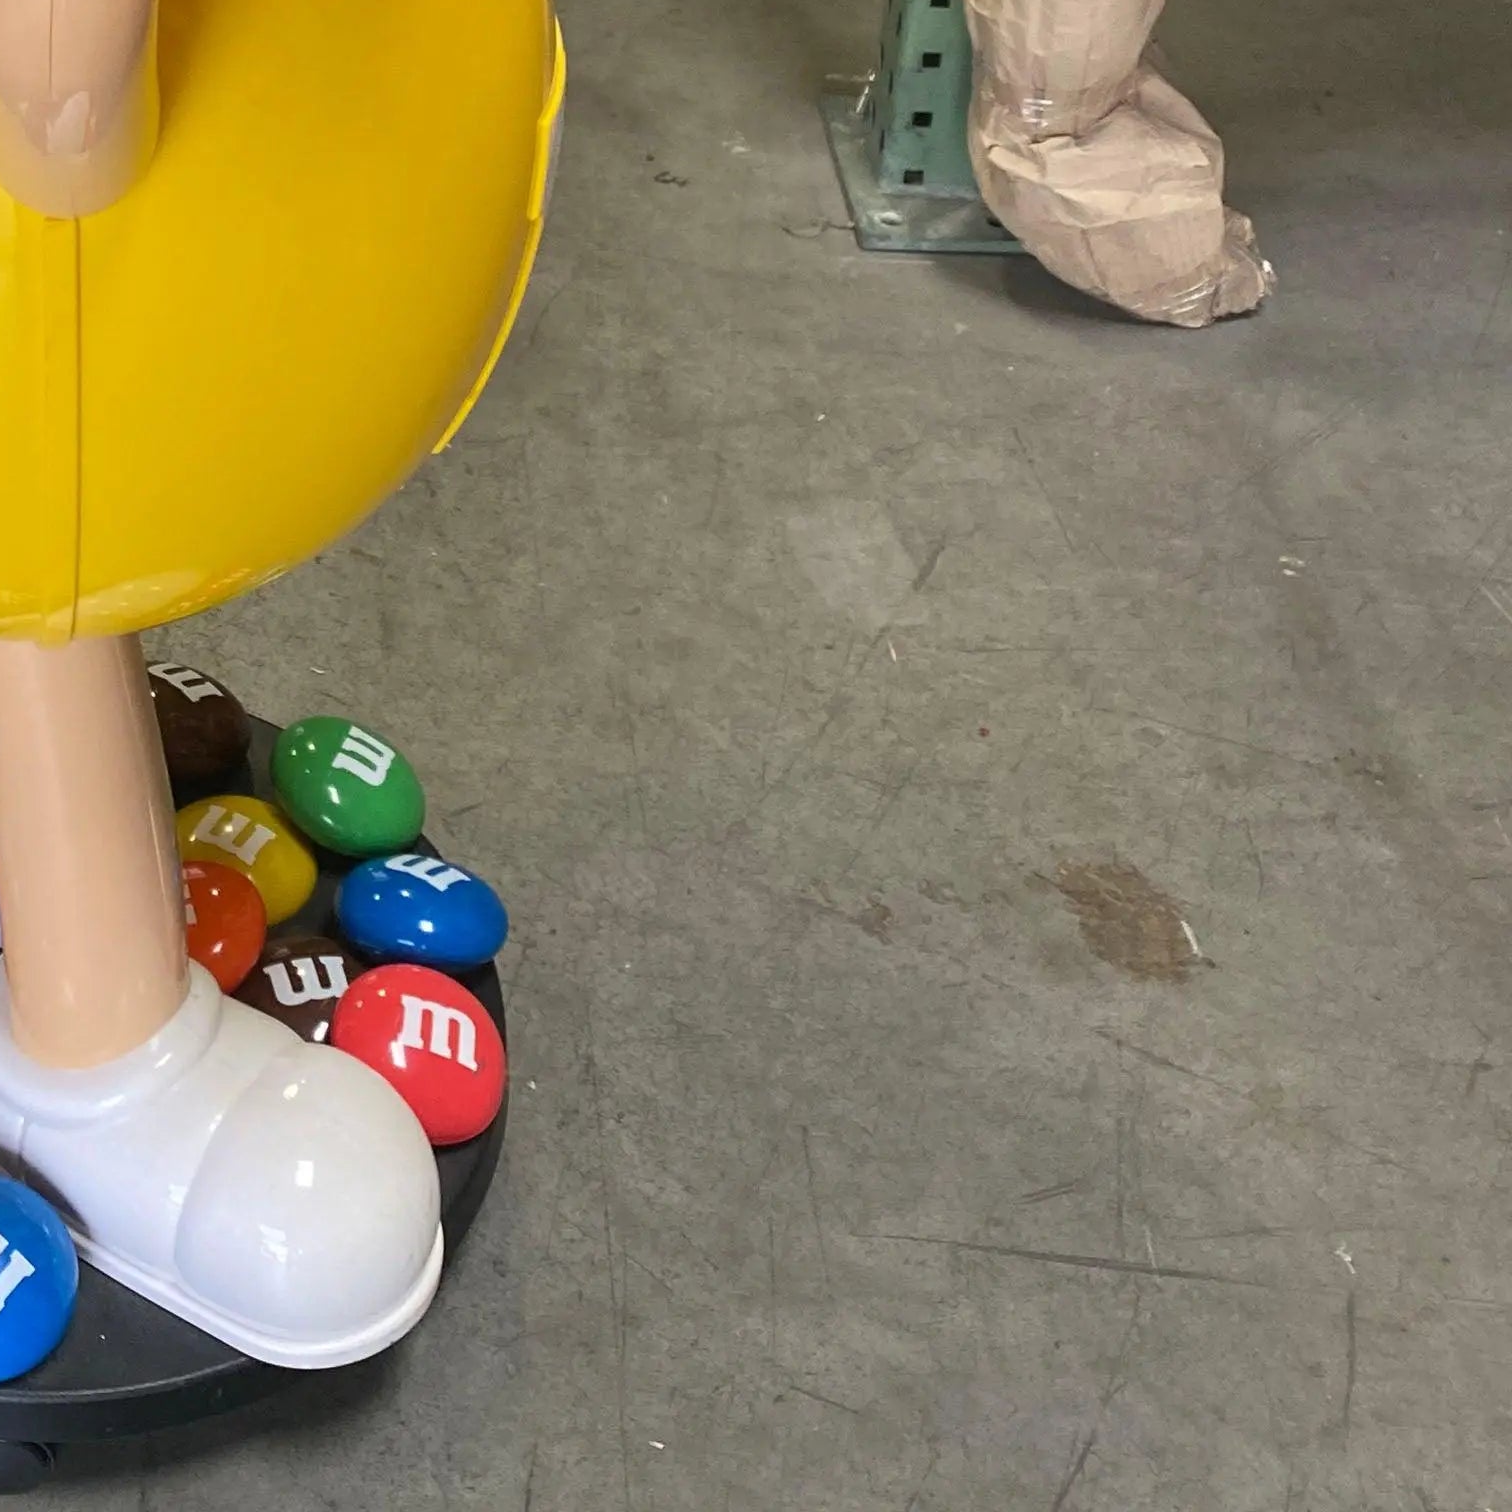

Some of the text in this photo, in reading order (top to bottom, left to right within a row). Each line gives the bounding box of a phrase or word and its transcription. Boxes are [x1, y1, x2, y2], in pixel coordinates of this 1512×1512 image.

[148, 663, 224, 702] m
[332, 726, 397, 786] m
[191, 805, 276, 866] m
[384, 854, 472, 892] m
[263, 955, 350, 1006] m
[397, 994, 478, 1072] m
